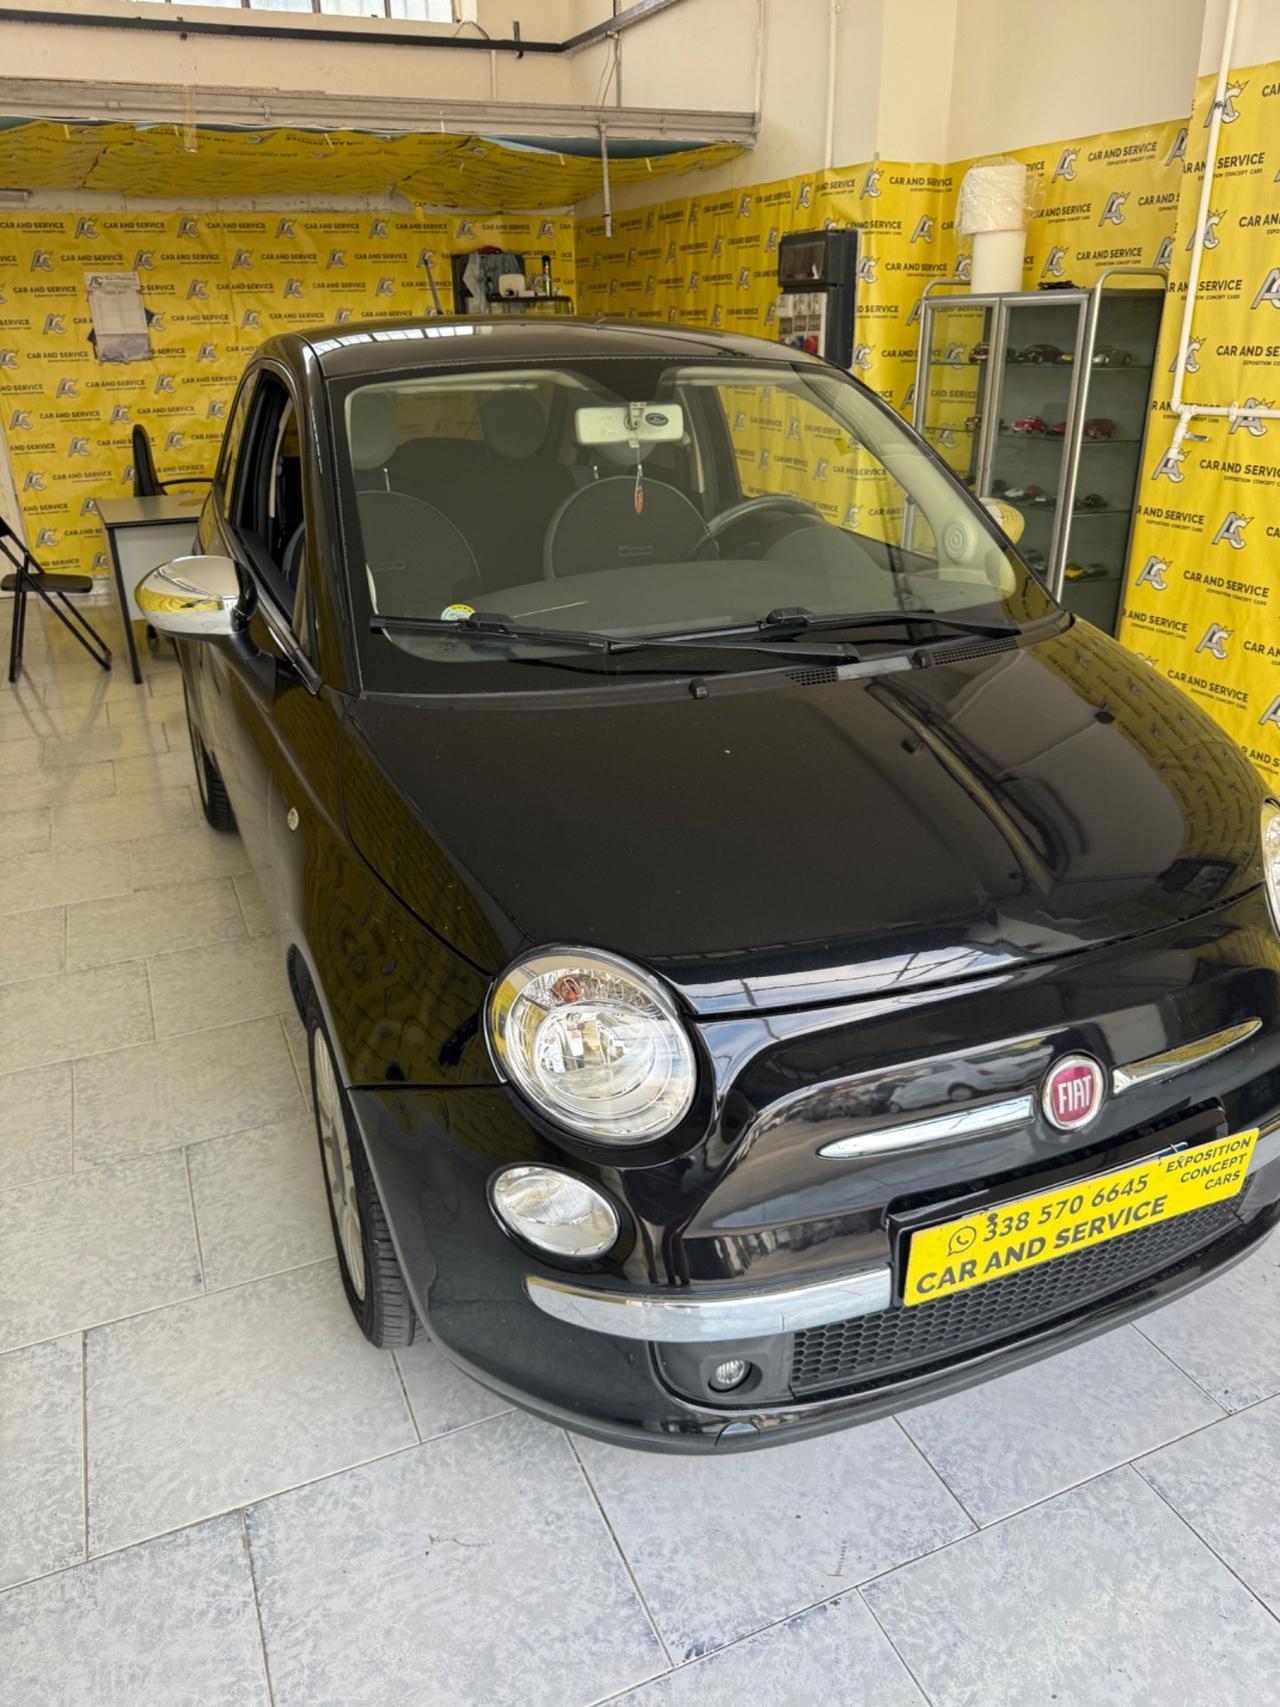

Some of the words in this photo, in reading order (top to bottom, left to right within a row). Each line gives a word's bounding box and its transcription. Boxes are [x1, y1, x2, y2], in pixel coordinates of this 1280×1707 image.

[1088, 150, 1103, 161] CAR
[1104, 147, 1122, 158] AND
[1123, 142, 1157, 156] SERVICE
[1194, 159, 1206, 171] AN
[1217, 152, 1265, 168] SERVICE
[1062, 203, 1091, 215] SERVICE
[1138, 195, 1154, 206] CAR
[1156, 193, 1175, 204] AND
[1239, 214, 1262, 228] CAR
[1076, 251, 1091, 260] CAR
[1092, 249, 1108, 259] AND
[1110, 247, 1142, 258] SERVICE
[1199, 279, 1242, 291] SERVICE
[1216, 345, 1237, 355] CAR
[1240, 345, 1262, 356] AND
[1200, 459, 1219, 471] CAR
[1221, 461, 1242, 473] AND
[1143, 506, 1163, 518] AND
[1165, 509, 1204, 524] SERVICE
[1183, 570, 1203, 583] CAR
[1204, 574, 1224, 588] AND
[1226, 579, 1268, 597] SERVICE
[1128, 610, 1147, 623] AND
[1148, 614, 1187, 631] SERVICE
[1244, 640, 1265, 653] CAR
[1168, 669, 1186, 683] CAR
[1188, 675, 1207, 689] AND
[1209, 681, 1247, 701] SERVICE
[1057, 1074, 1092, 1114] FIAT
[1166, 1136, 1252, 1173] EXPOSITION
[1180, 1153, 1248, 1183] CONCEPT
[1204, 1170, 1241, 1190] CARS
[982, 1211, 1030, 1242] 338
[1038, 1194, 1084, 1225] 570
[1091, 1174, 1149, 1208] 6645
[916, 1260, 978, 1294] CAR
[983, 1236, 1046, 1274] AND
[1053, 1194, 1168, 1249] SERVICE
